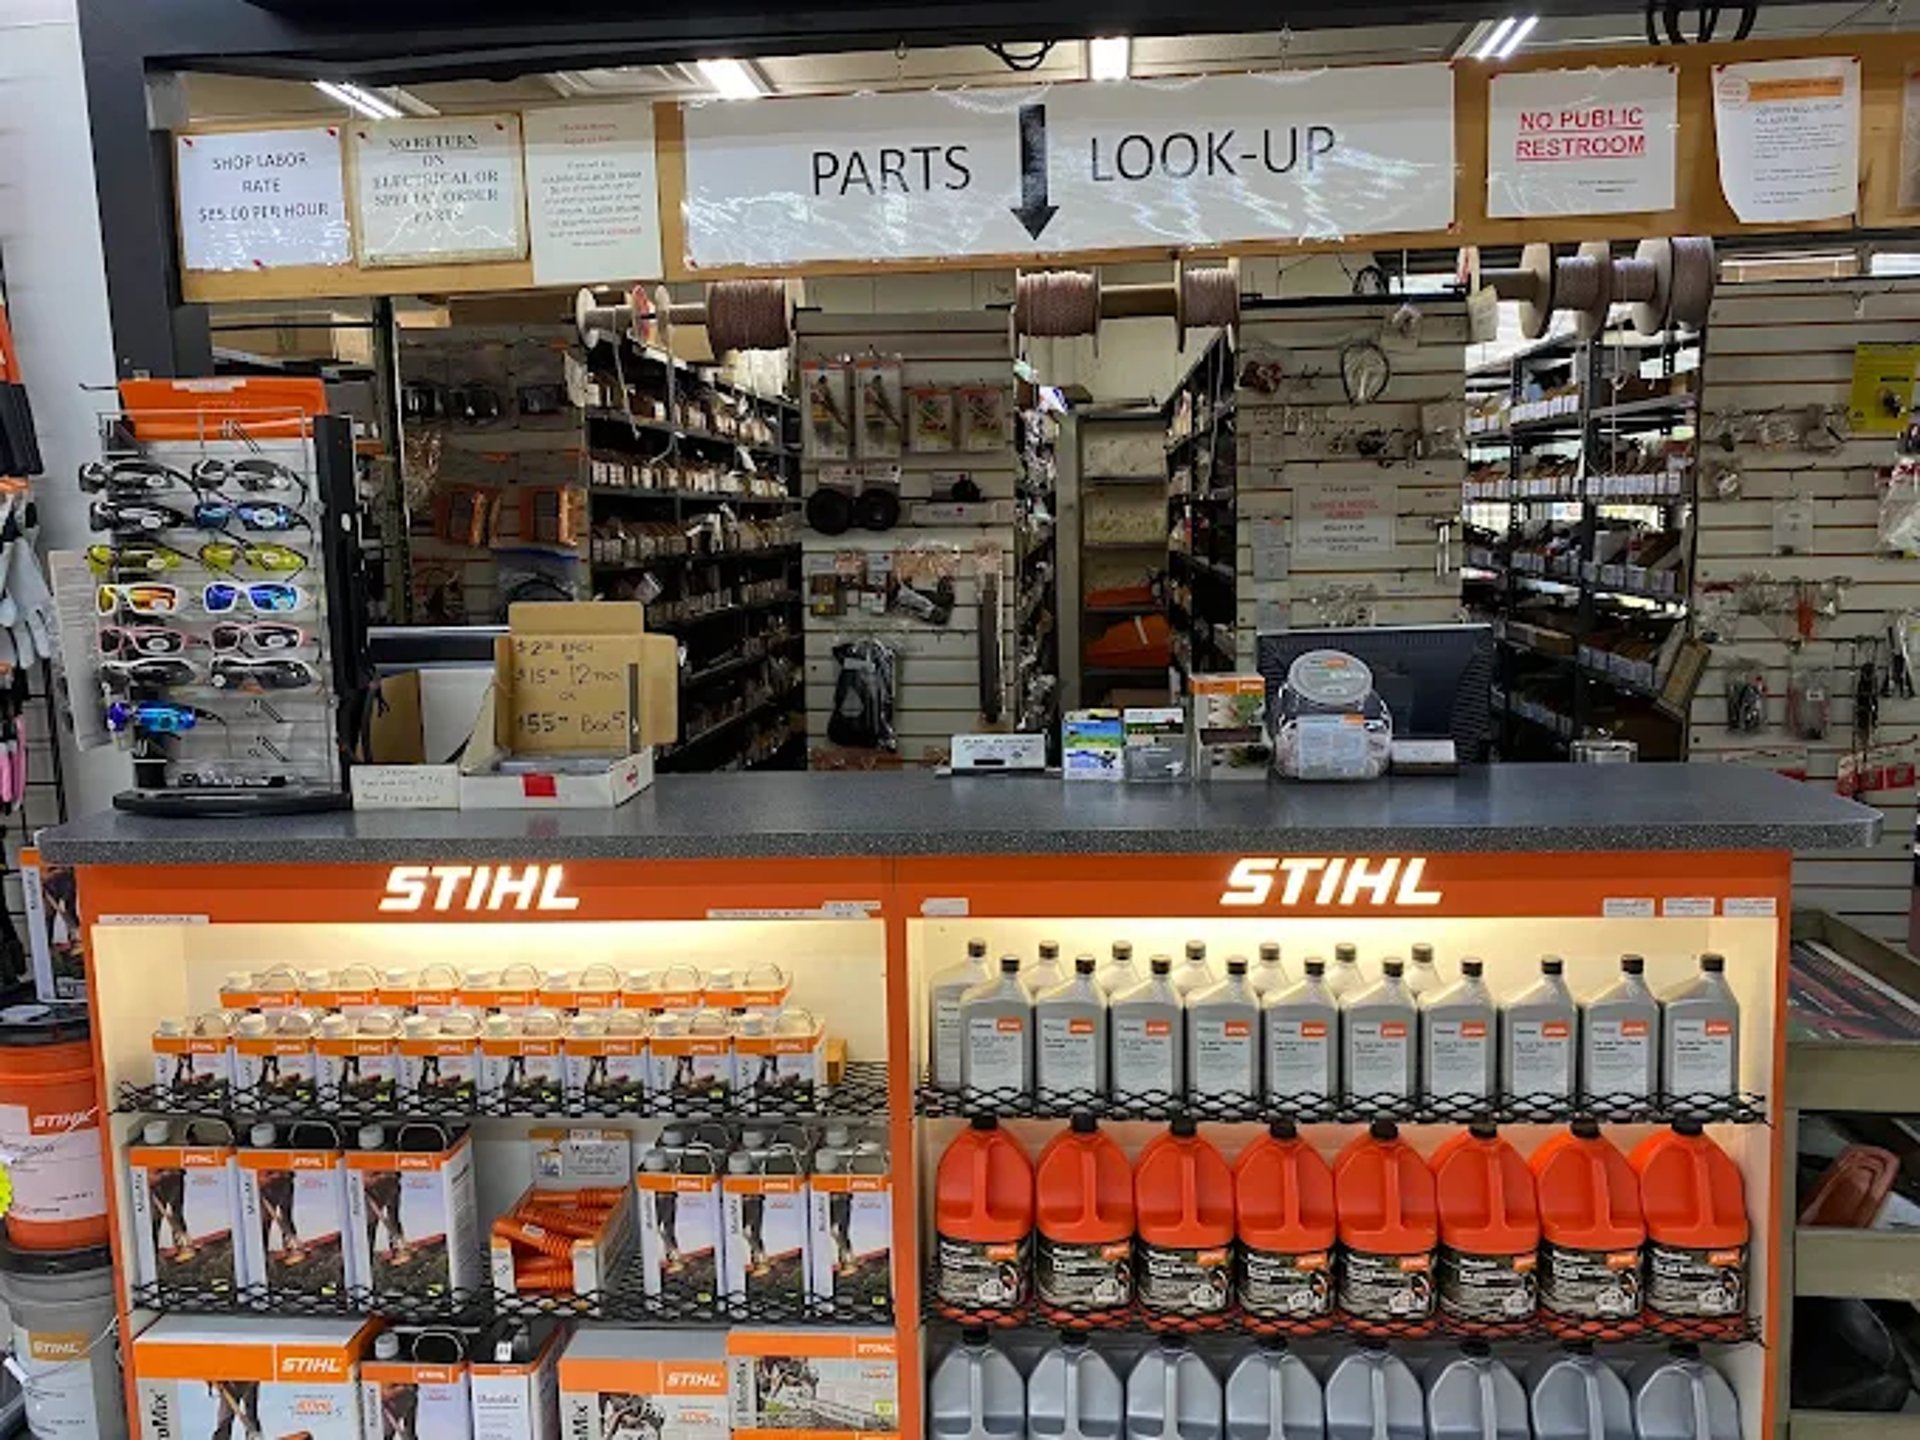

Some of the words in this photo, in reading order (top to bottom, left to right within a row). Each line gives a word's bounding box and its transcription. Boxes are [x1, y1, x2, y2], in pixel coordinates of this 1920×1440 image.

[1520, 111, 1551, 131] NO
[1559, 107, 1643, 129] PUBLIC
[388, 137, 411, 149] NO
[413, 134, 478, 148] RETURN
[1516, 135, 1646, 157] RESTROOM
[211, 155, 253, 171] SHOP
[257, 152, 310, 168] LABOR
[422, 155, 444, 167] ON
[812, 145, 971, 196] PARTS
[1091, 126, 1336, 182] LOOK-UP
[242, 177, 281, 193] RATE
[373, 172, 472, 190] ELECTRICAL
[475, 171, 498, 182] OR
[443, 188, 499, 203] ORDER
[253, 204, 281, 219] PER
[284, 202, 329, 218] HOUR
[378, 865, 581, 911] STIHL
[1219, 858, 1443, 905] STIHL
[33, 1341, 79, 1353] STIHL
[281, 1357, 342, 1373] STIHL
[666, 1372, 721, 1388] STIHL
